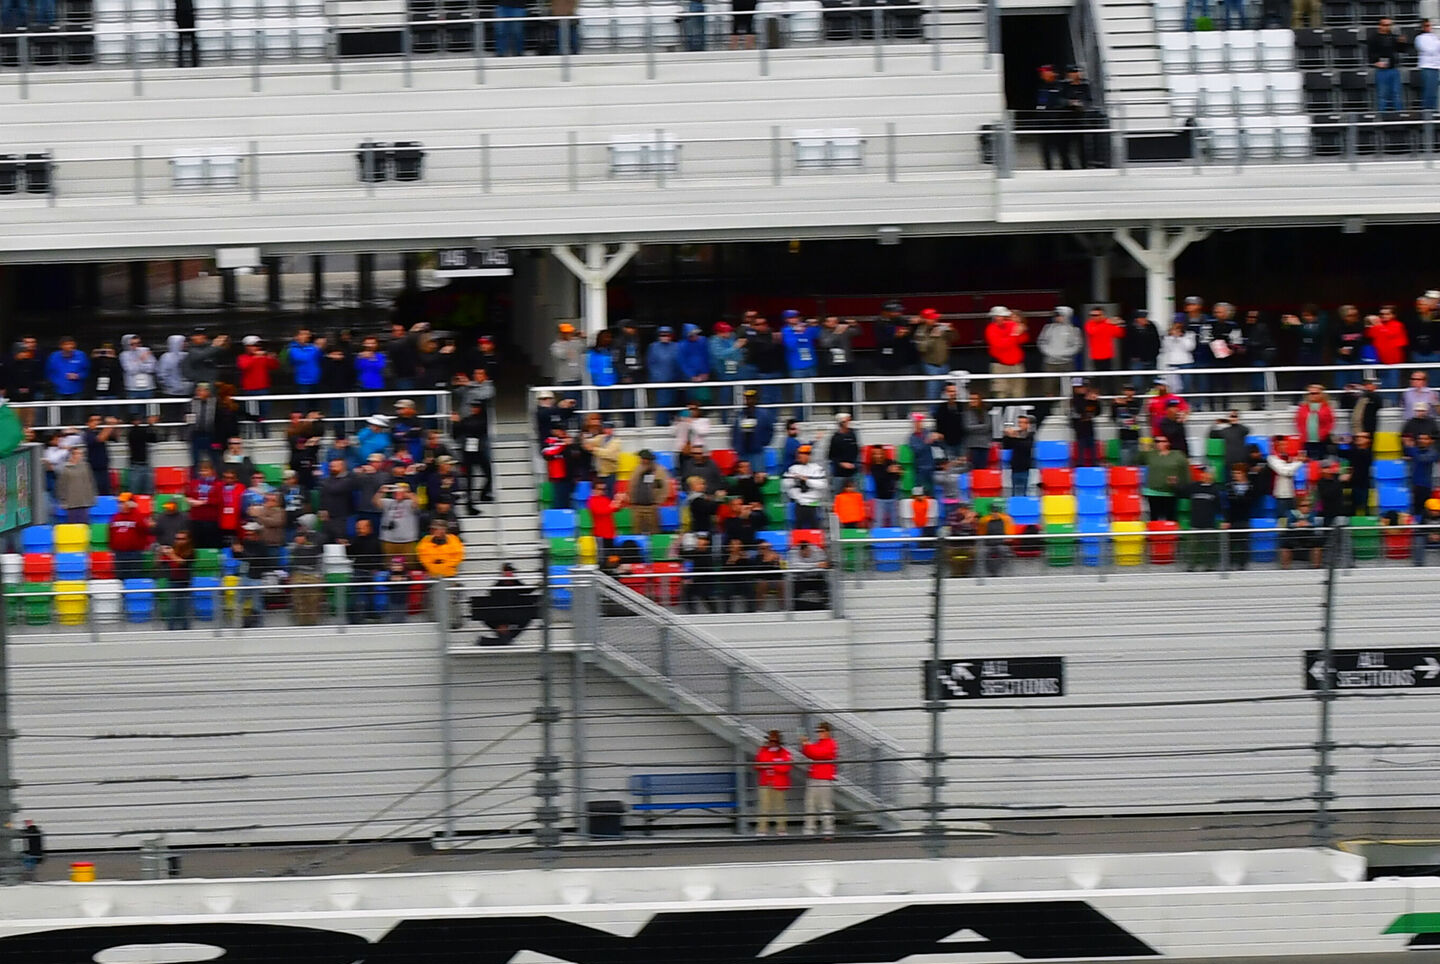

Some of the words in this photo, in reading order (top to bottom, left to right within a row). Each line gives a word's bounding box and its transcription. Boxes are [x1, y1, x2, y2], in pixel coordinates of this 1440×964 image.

[980, 660, 1012, 677] ALL
[1357, 652, 1389, 668] ALL
[980, 678, 1060, 695] SECTIONS
[1337, 669, 1416, 687] SECTIONS
